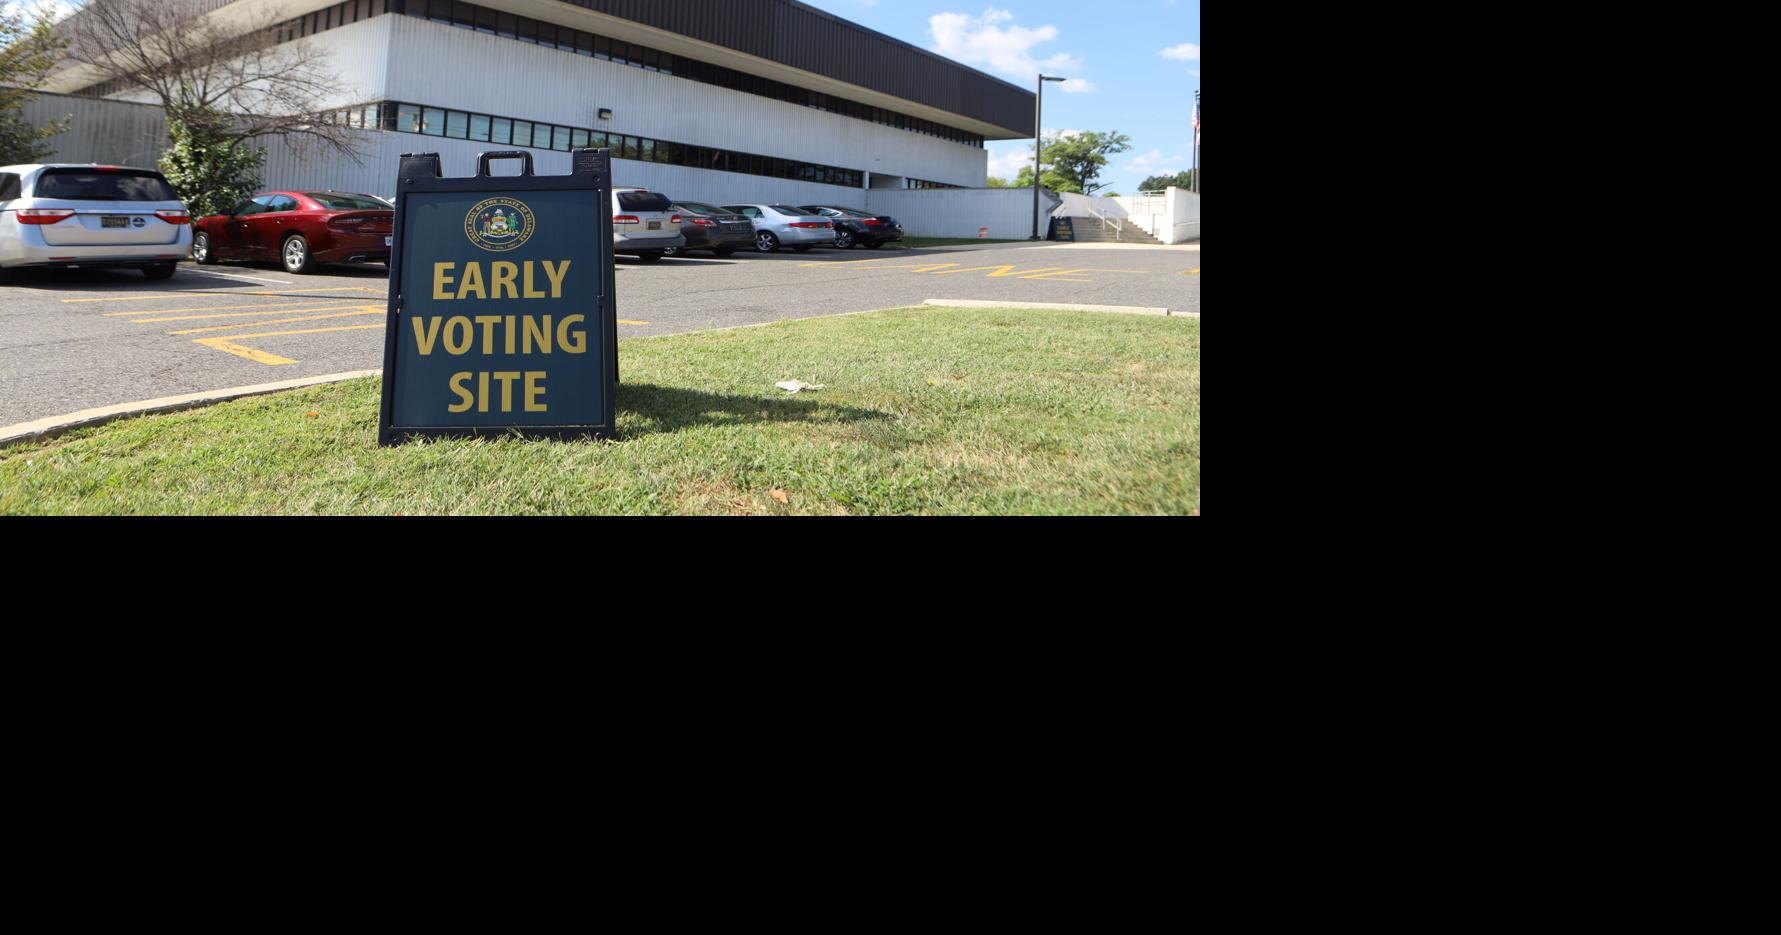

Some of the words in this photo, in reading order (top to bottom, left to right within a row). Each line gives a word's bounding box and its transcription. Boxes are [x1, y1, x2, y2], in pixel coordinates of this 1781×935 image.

[432, 260, 571, 300] EARLY
[411, 313, 587, 355] VOTING
[447, 370, 548, 413] SITE
